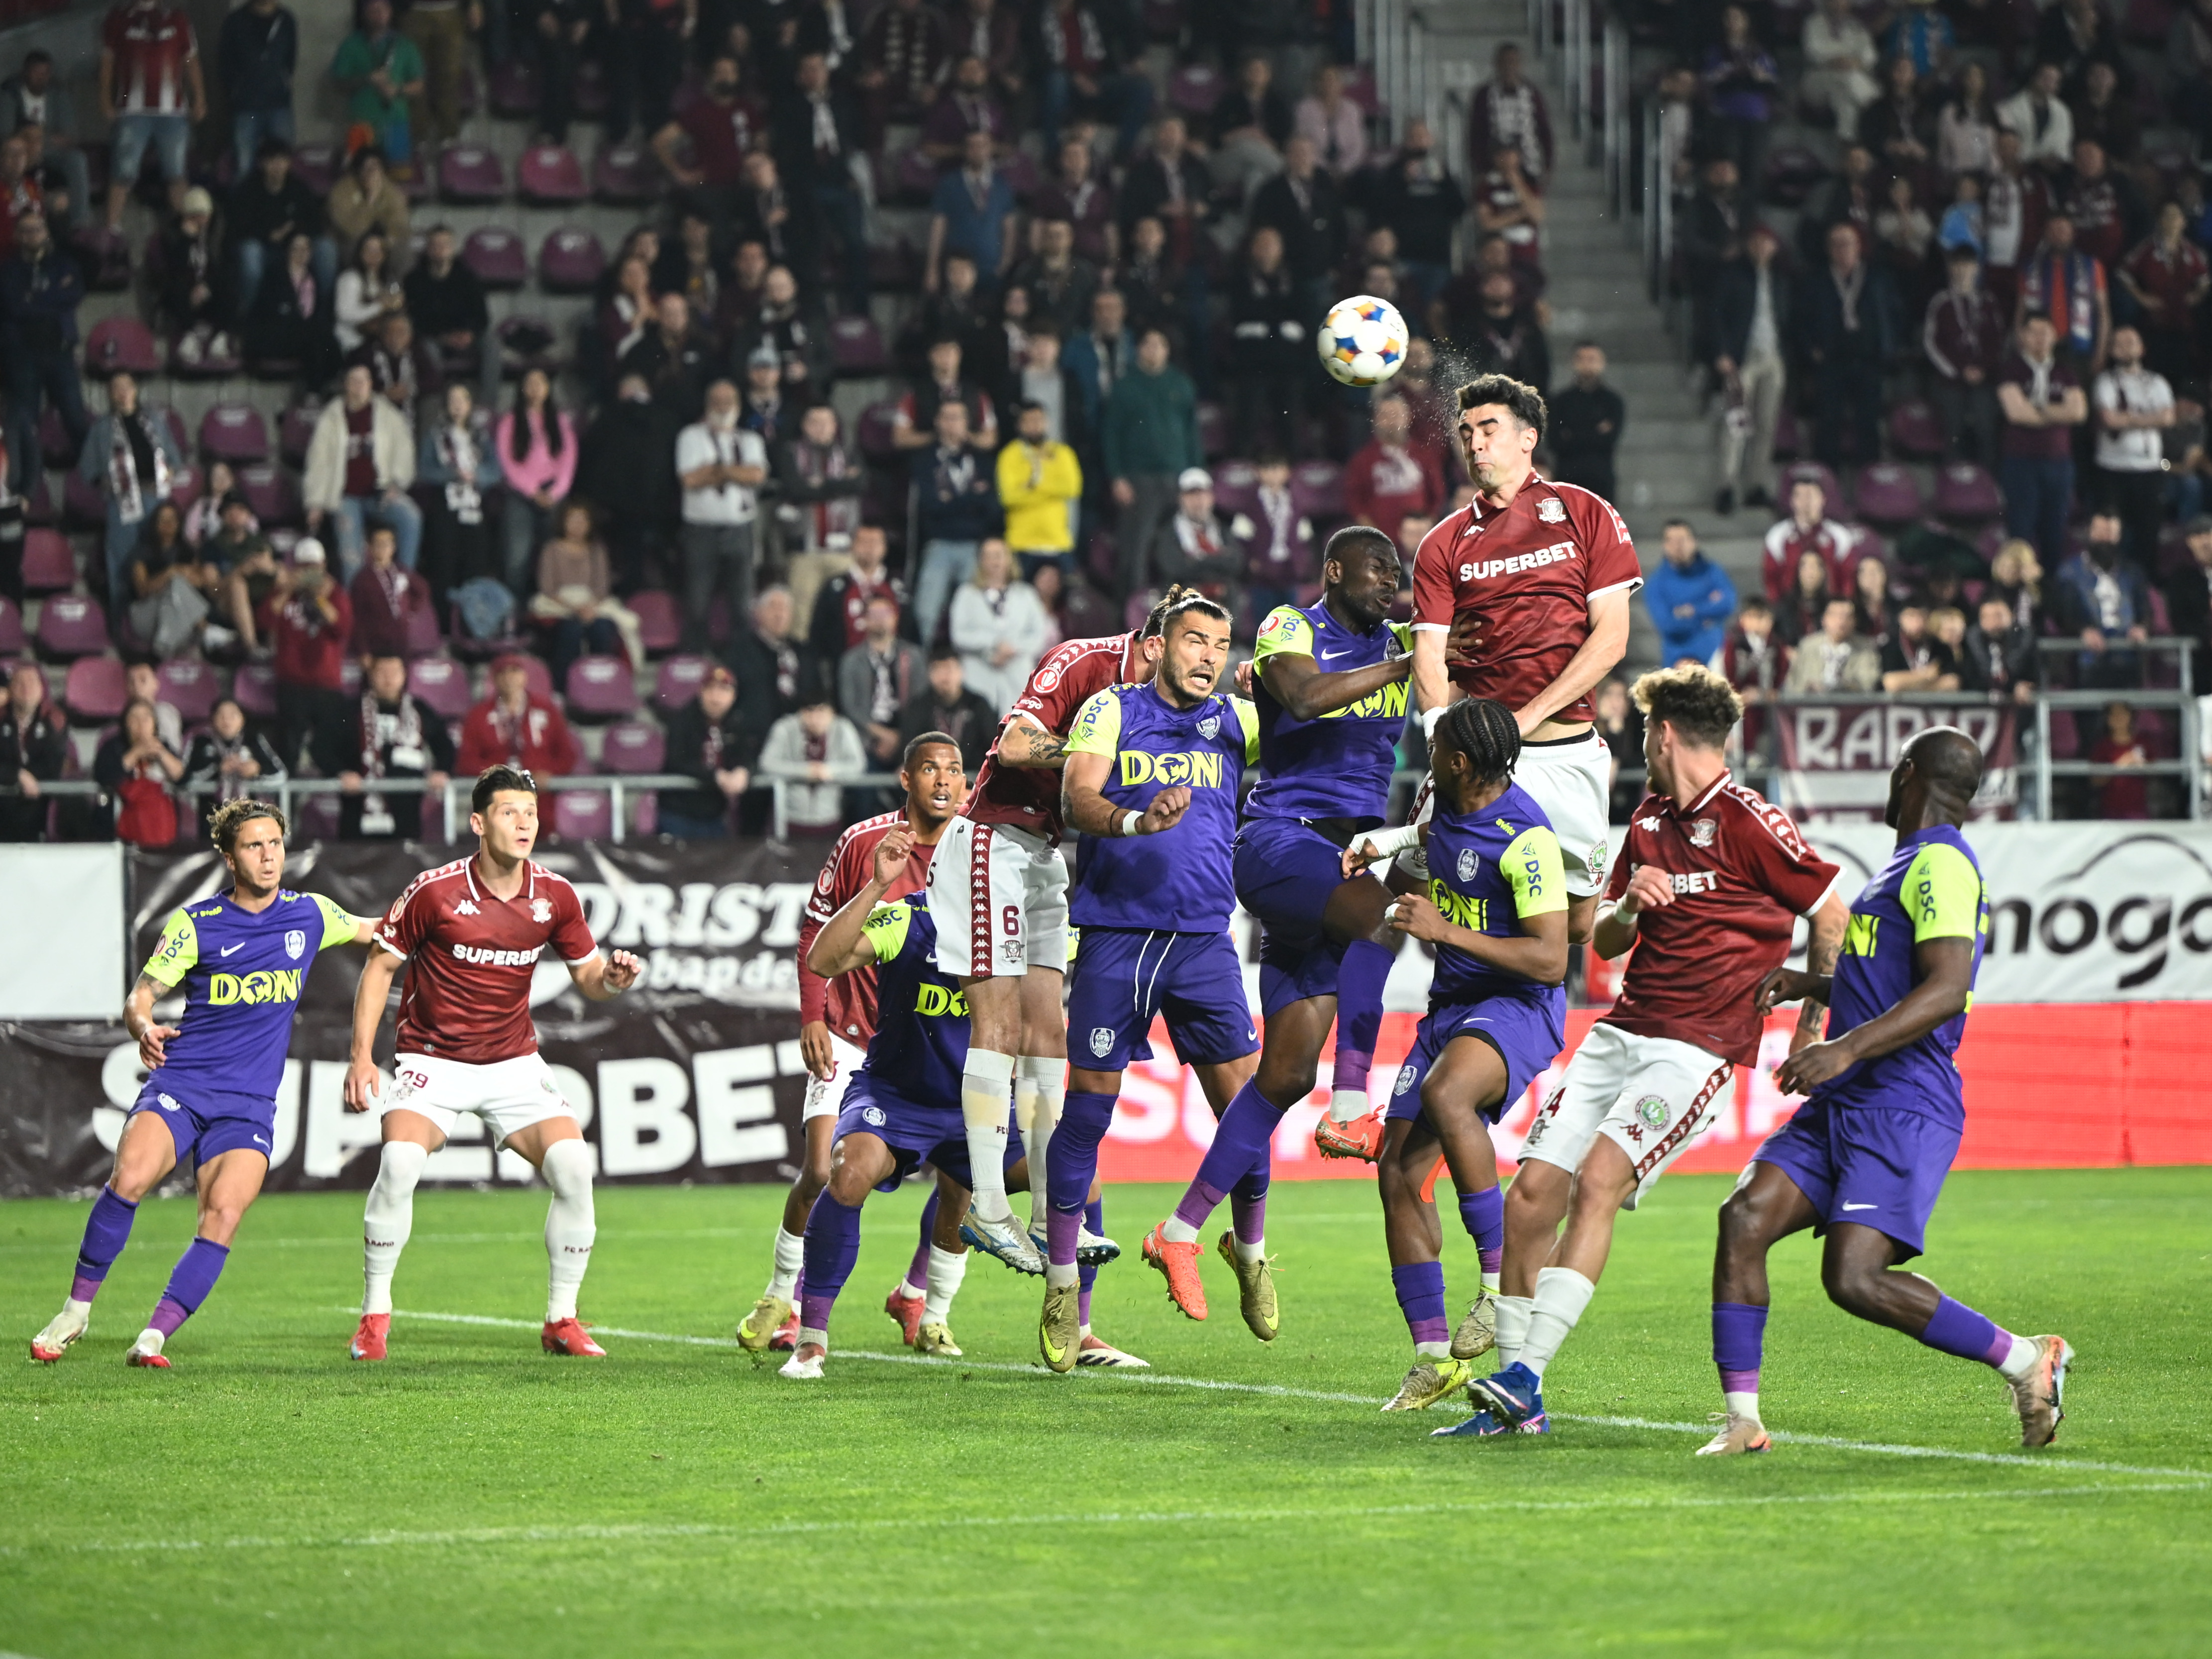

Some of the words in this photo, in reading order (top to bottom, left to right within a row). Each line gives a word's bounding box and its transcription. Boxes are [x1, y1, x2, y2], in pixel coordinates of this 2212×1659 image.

[1460, 541, 1576, 582] SUPERBET
[1282, 615, 1305, 631] DS
[1020, 698, 1043, 710] mogo
[1083, 697, 1109, 724] DSC
[1319, 674, 1412, 718] ON
[1119, 750, 1223, 789] DON
[1495, 818, 1516, 836] avinto
[1525, 859, 1542, 898] DSC
[1428, 871, 1489, 931] ON
[1919, 880, 1936, 922] DSC
[1002, 905, 1019, 935] 6
[165, 929, 190, 958] DSC
[452, 943, 545, 966] SUPERBE
[208, 968, 302, 1005] DON
